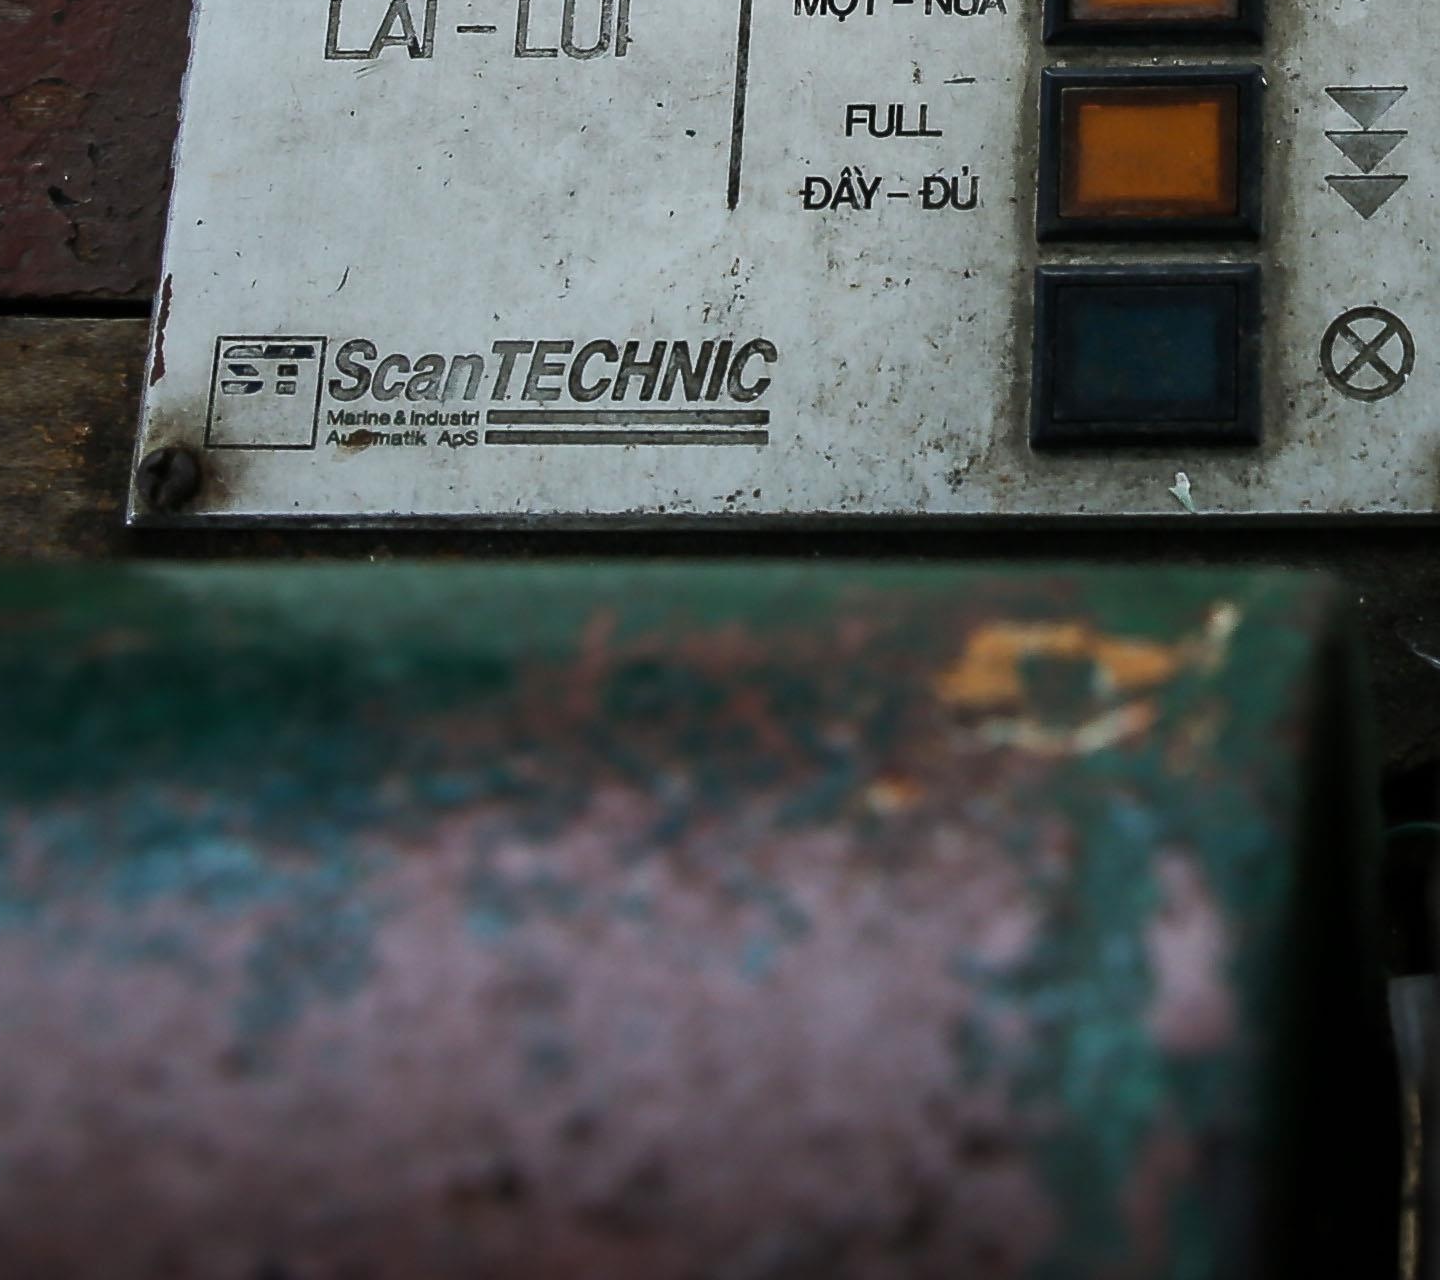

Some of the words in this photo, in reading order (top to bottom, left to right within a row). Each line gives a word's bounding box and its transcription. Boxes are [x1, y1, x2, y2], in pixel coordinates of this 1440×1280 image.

[845, 103, 943, 138] FULL
[327, 337, 778, 402] ScanTECHNIC
[326, 409, 391, 426] Marine
[325, 429, 427, 446] Aumatik
[437, 430, 479, 449] ApS
